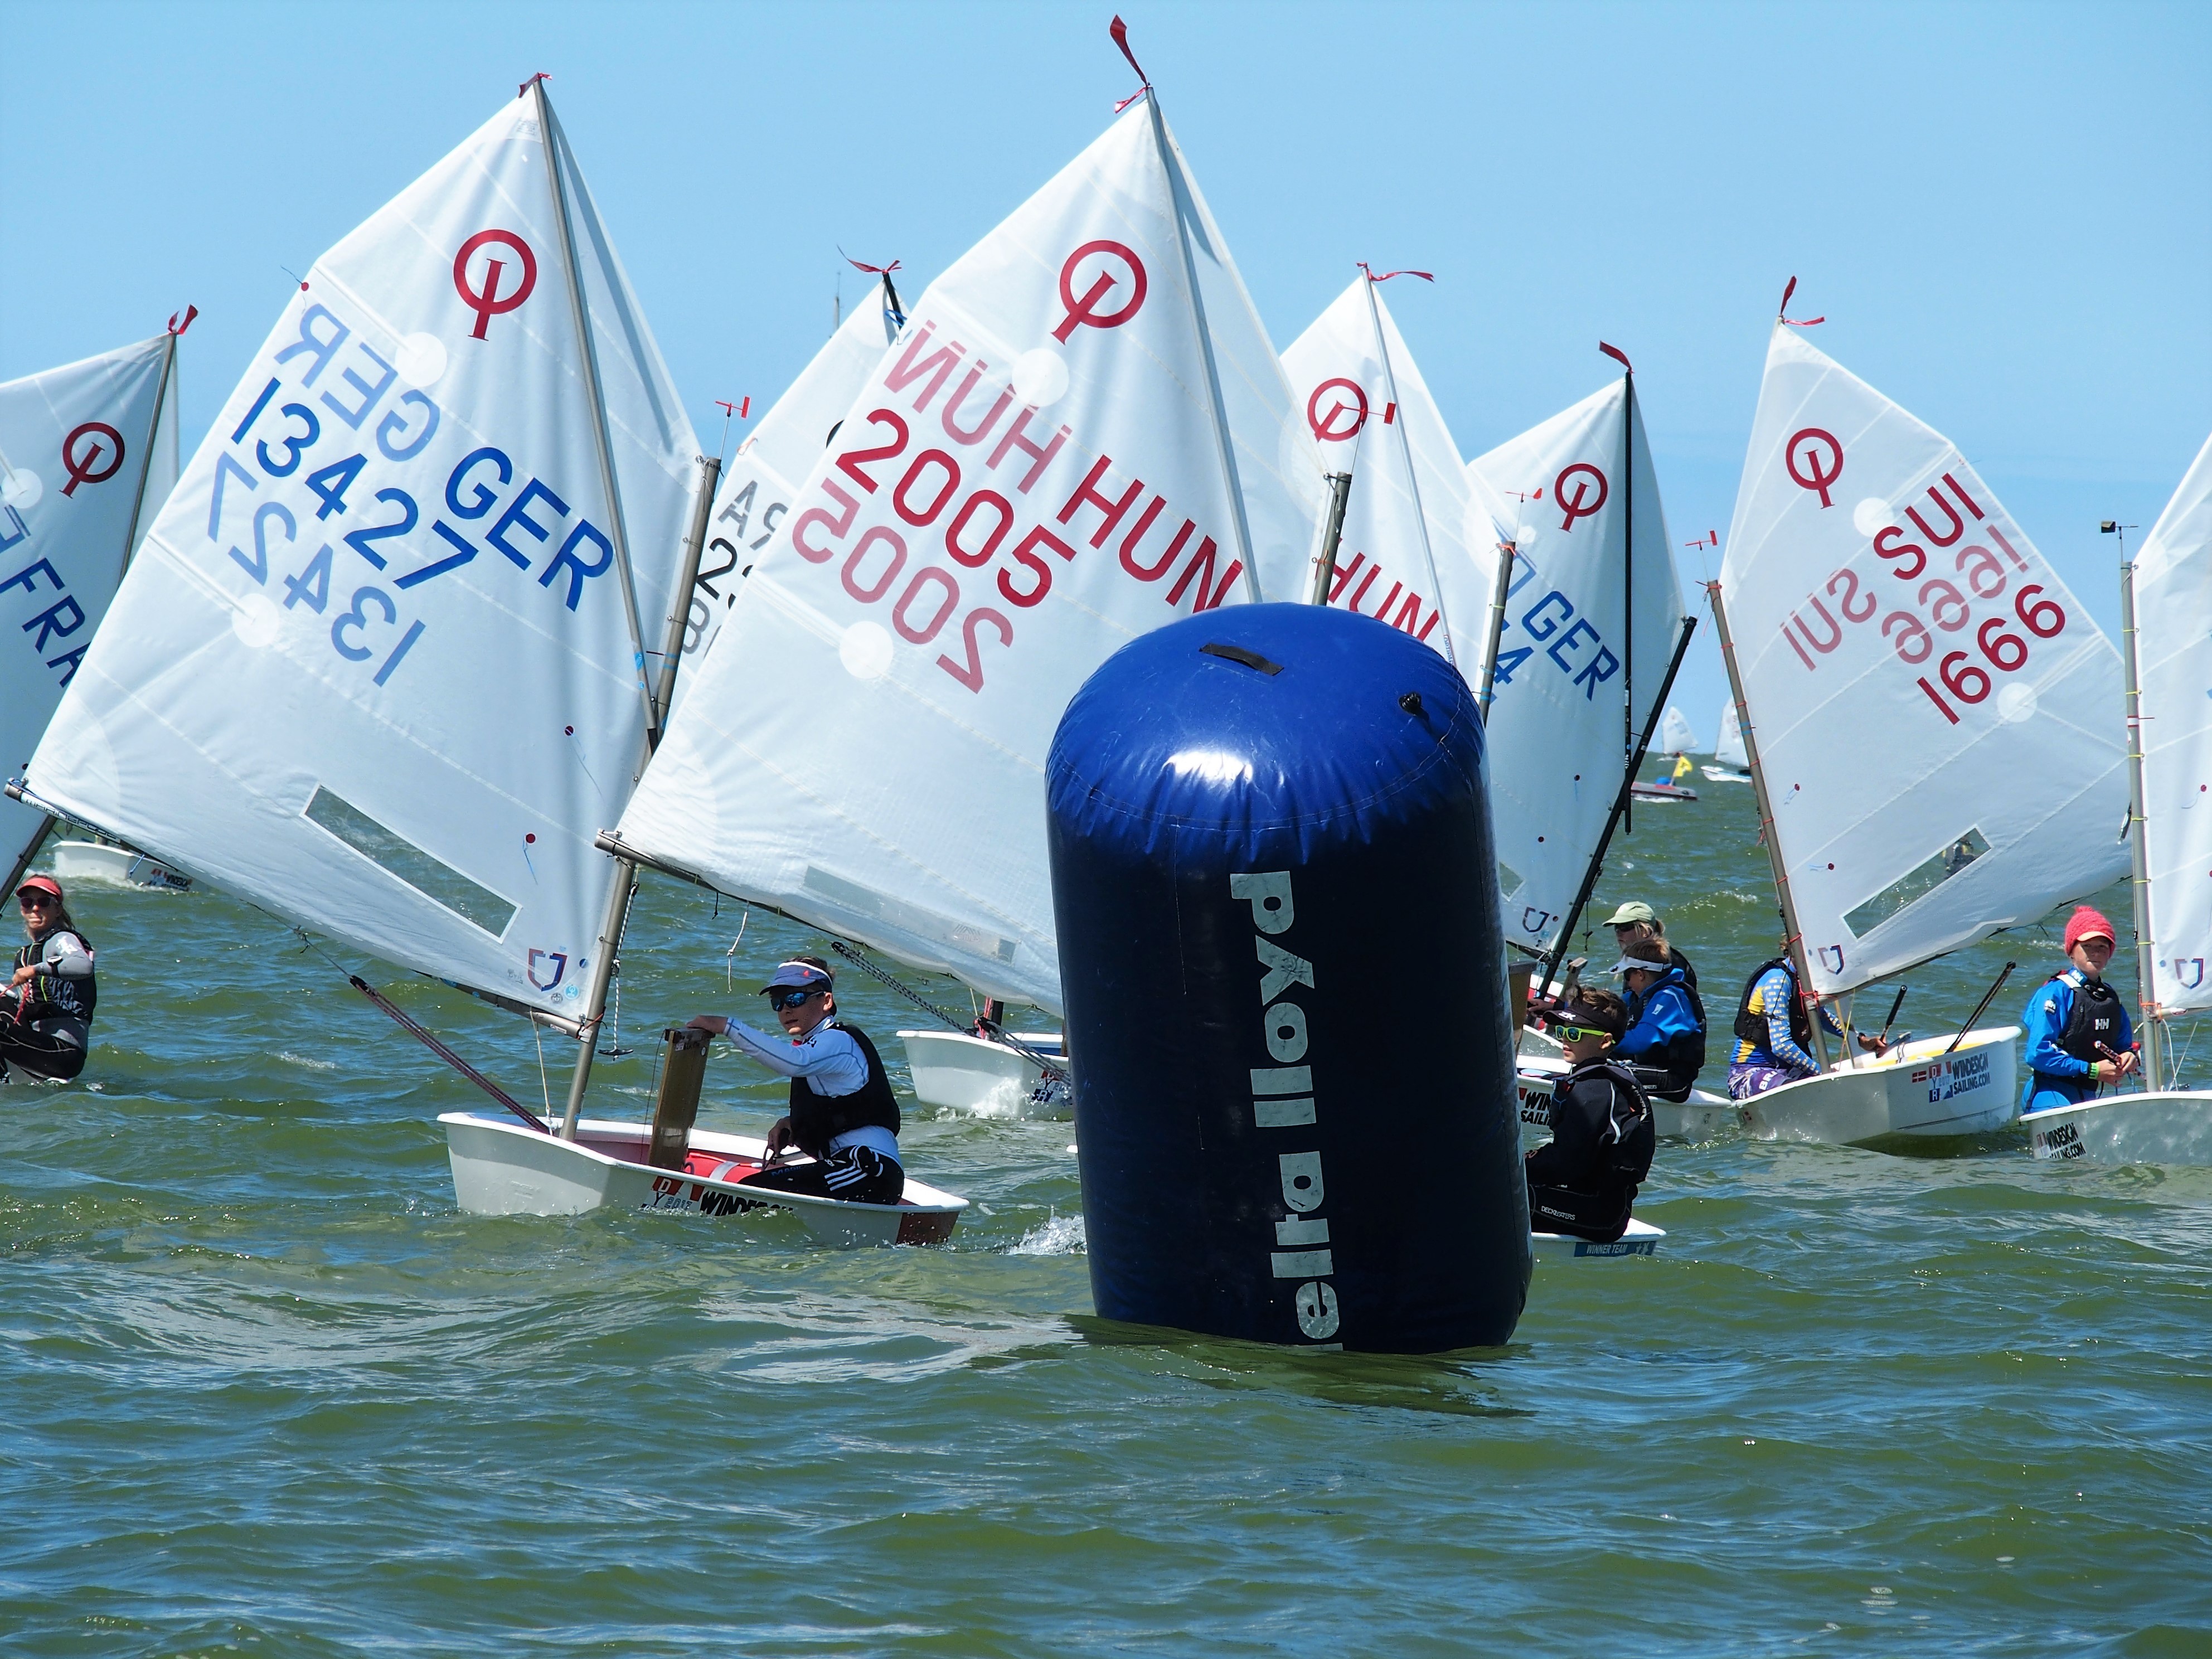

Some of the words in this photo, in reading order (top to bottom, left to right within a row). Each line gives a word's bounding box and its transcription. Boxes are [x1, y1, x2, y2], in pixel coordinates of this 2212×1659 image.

[231, 377, 479, 589] 13427
[446, 447, 614, 612] GER
[836, 409, 1076, 607] 2005
[1056, 454, 1243, 613] HUN
[1873, 473, 1985, 580] SUI
[0, 557, 91, 687] FRA
[1314, 537, 1439, 641] HUN
[1521, 590, 1619, 701] GER
[1917, 585, 2065, 725] 1666
[1230, 870, 1317, 1127] lloyd
[1525, 1092, 1551, 1111] WIN
[1932, 1090, 1937, 1100] R
[653, 1192, 666, 1207] Y
[664, 1196, 693, 1210] 2017
[658, 1178, 672, 1192] D
[700, 1190, 793, 1216] WINDE
[1270, 1151, 1343, 1351] elta
[1587, 1244, 1611, 1254] WINNER
[1612, 1244, 1628, 1254] TEAM
